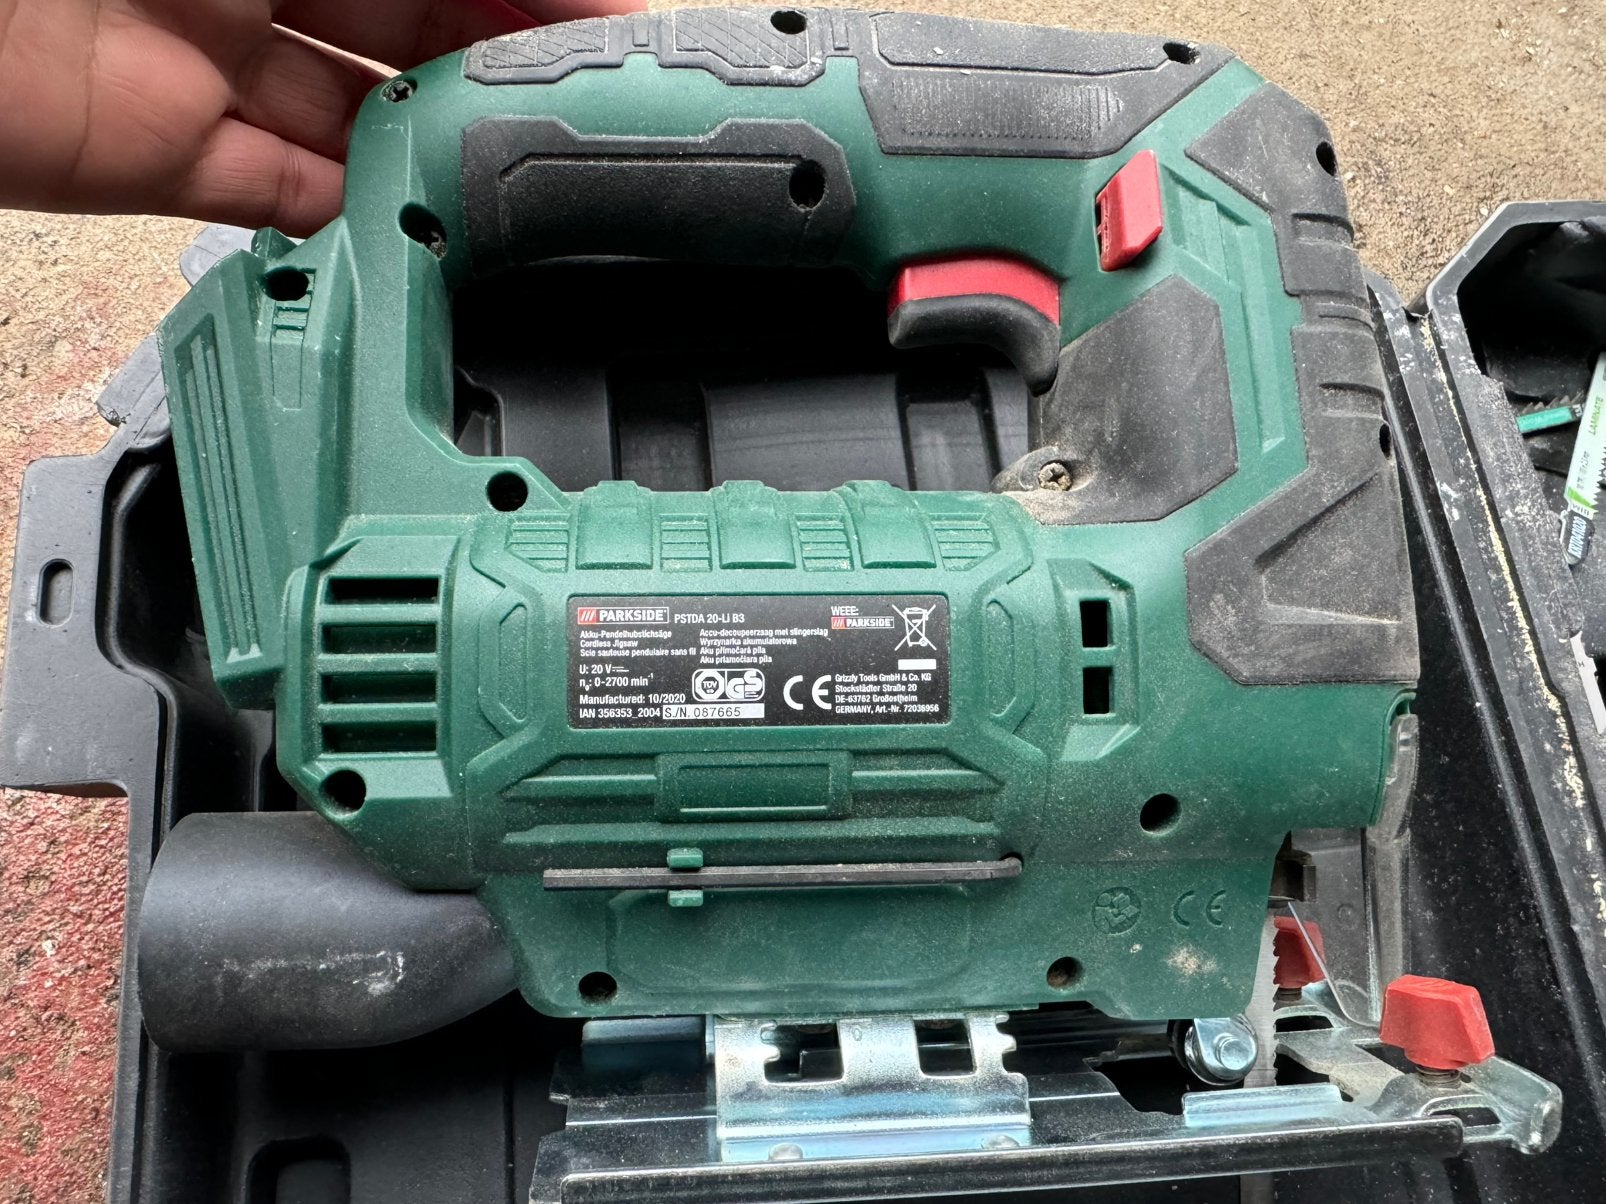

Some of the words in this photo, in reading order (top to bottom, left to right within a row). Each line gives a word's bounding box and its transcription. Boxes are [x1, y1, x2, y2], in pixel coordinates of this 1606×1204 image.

[599, 609, 664, 622] PARKSIDE
[674, 614, 704, 624] PSTDA
[706, 613, 730, 624] 20-Li
[732, 613, 745, 623] B3
[846, 618, 891, 628] PARKSIDE
[580, 630, 672, 639] Akku-Pendelhubstichsäge
[775, 628, 789, 636] met
[790, 627, 829, 637] slingerslag
[580, 639, 611, 648] Cordless
[612, 639, 639, 649] Jigsaw
[580, 649, 596, 657] Scie
[598, 648, 630, 656] sauteuse
[631, 648, 669, 657] pendulaire
[670, 648, 688, 656] sans
[689, 647, 697, 655] fil
[699, 646, 714, 655] Aku
[699, 655, 715, 664] Aku
[579, 664, 589, 674] U:
[591, 664, 603, 674] 20
[835, 674, 858, 683] Grizzly
[859, 674, 877, 682] Tools
[879, 673, 901, 681] GmbH
[901, 673, 908, 681] &
[908, 673, 920, 681] Co.
[921, 673, 932, 681] KG
[783, 675, 832, 710] CE
[907, 684, 918, 692] 20
[579, 693, 646, 704] Manufactured:
[648, 693, 686, 704] 10/2020
[835, 694, 871, 703] DE-63762
[579, 708, 596, 718] IAN
[597, 708, 661, 719] 356353_2004
[693, 707, 741, 718] 087665
[835, 705, 874, 714] GERMANY,
